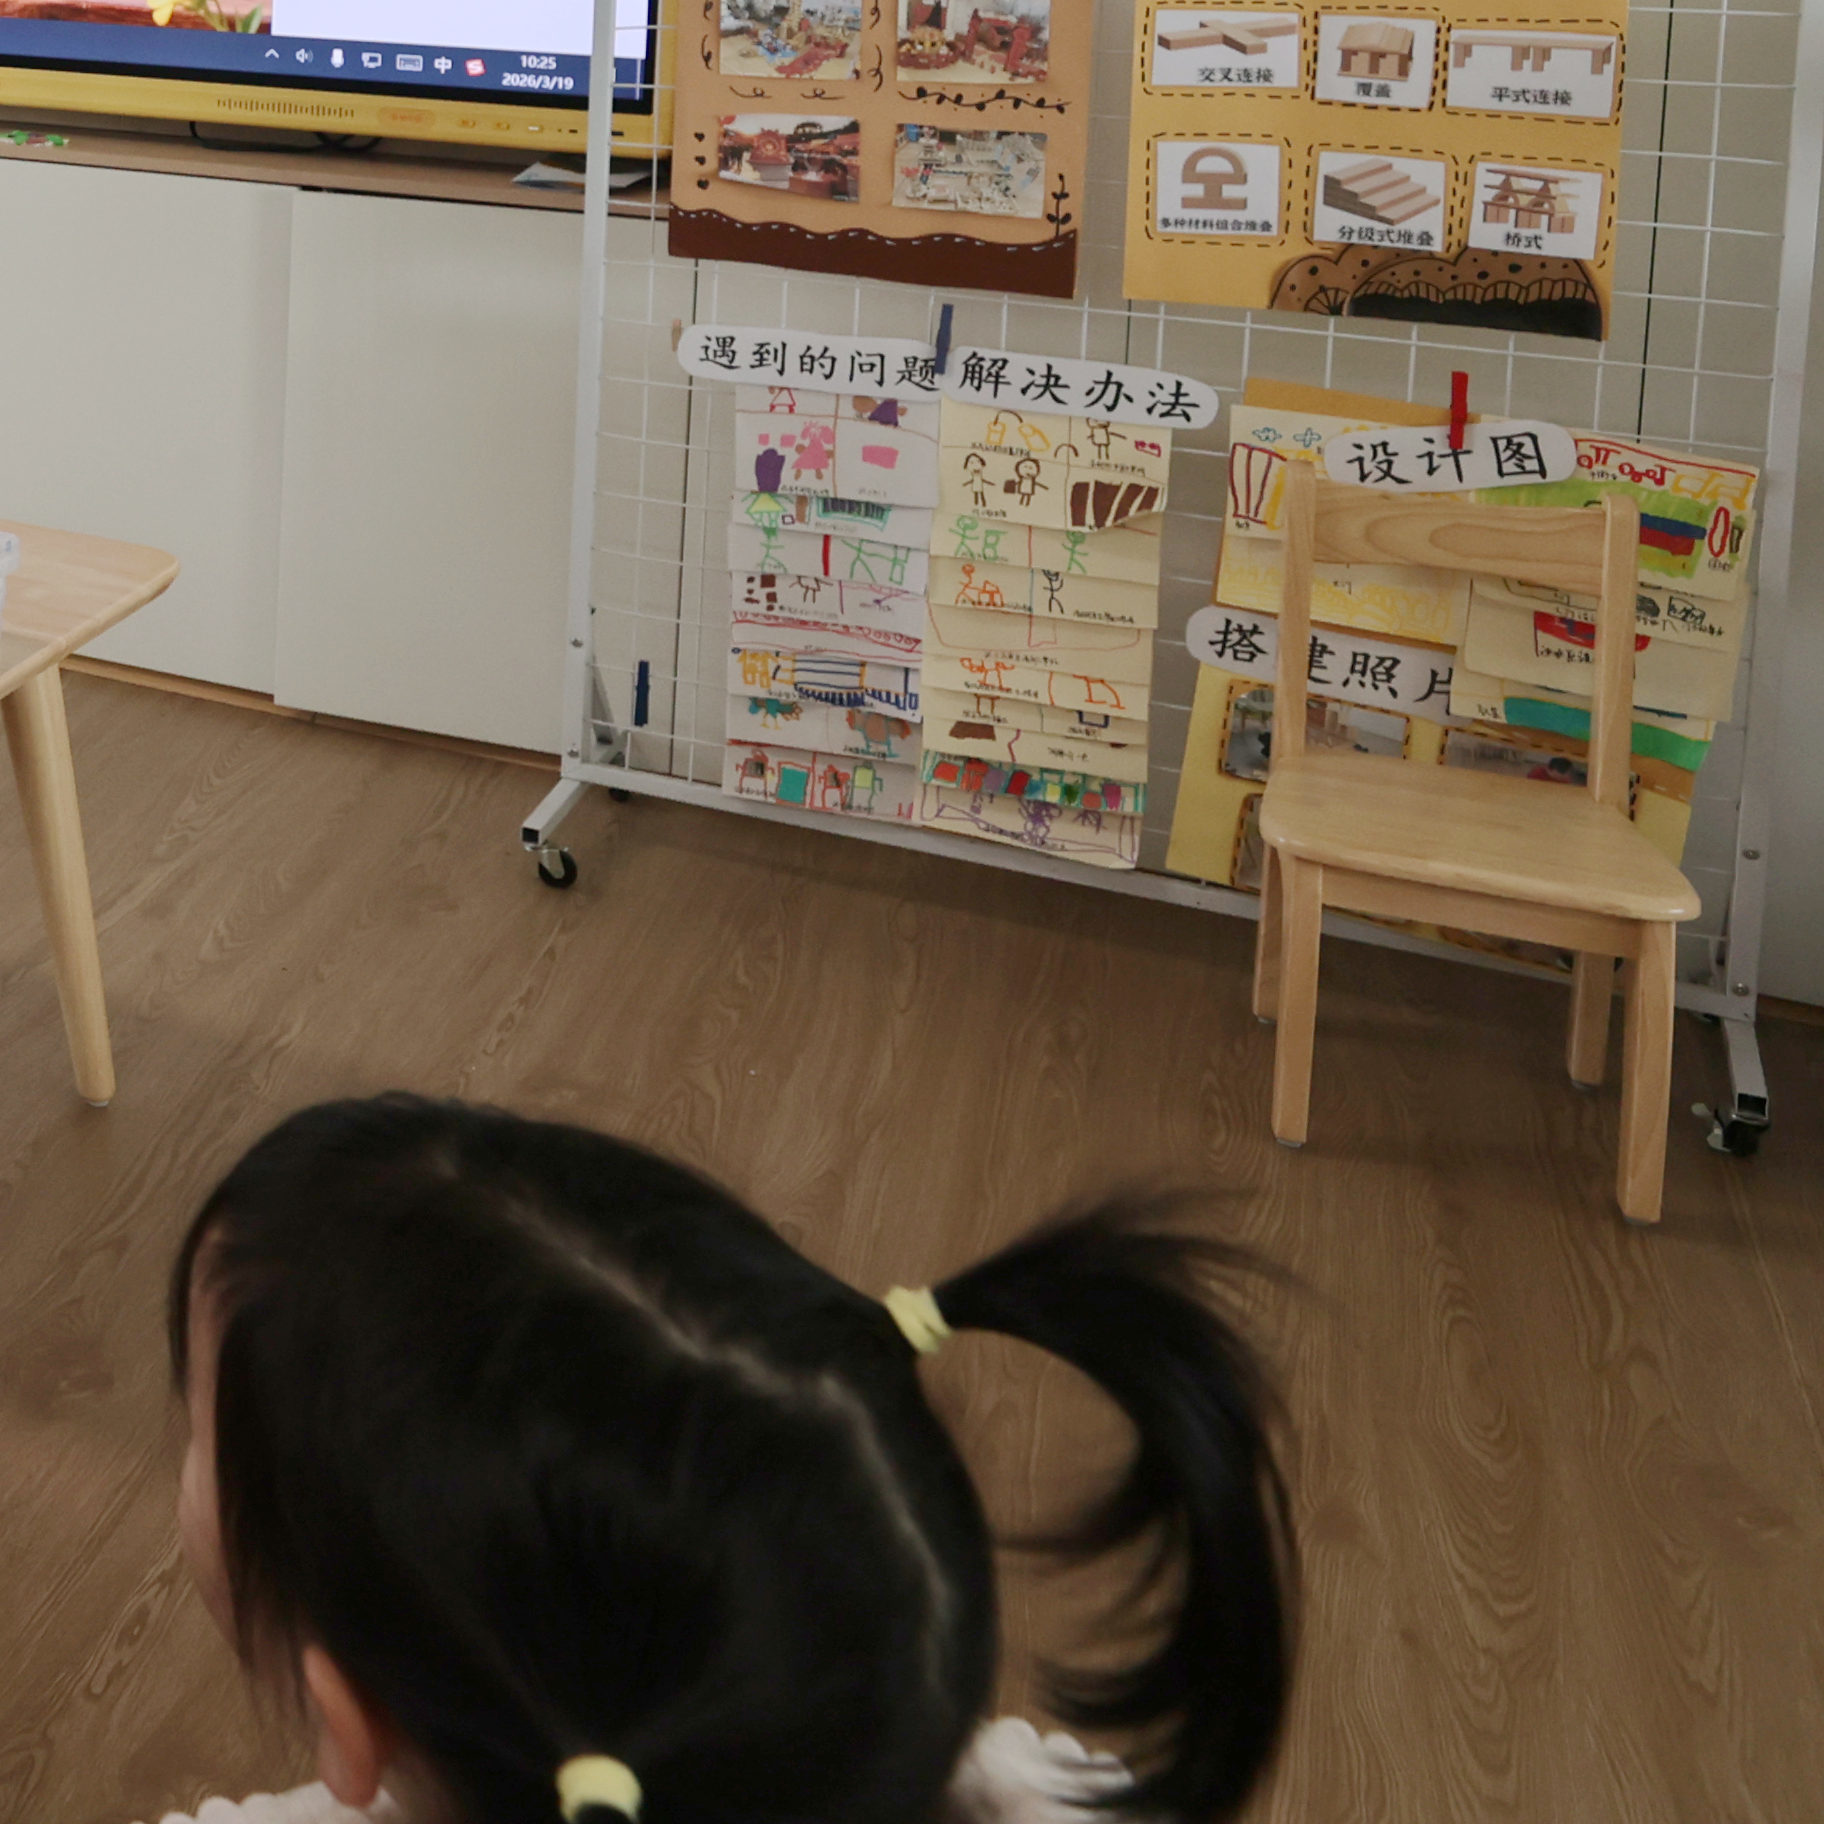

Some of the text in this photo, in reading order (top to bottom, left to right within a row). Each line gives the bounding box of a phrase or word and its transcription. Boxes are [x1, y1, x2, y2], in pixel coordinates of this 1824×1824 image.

[520, 55, 557, 71] 10:25
[501, 72, 574, 90] 2026/3/19
[1197, 67, 1274, 84] 交叉连接
[1355, 82, 1392, 99] 覆盖
[1491, 87, 1572, 107] 平式连接
[1159, 217, 1273, 233] 多种材料组合堆叠
[1337, 225, 1434, 247] 分级式堆叠
[1503, 231, 1543, 250] 桥式
[698, 334, 941, 392] 遇到的问题
[958, 352, 1201, 422] 解决办法
[1347, 431, 1548, 484] 设计图
